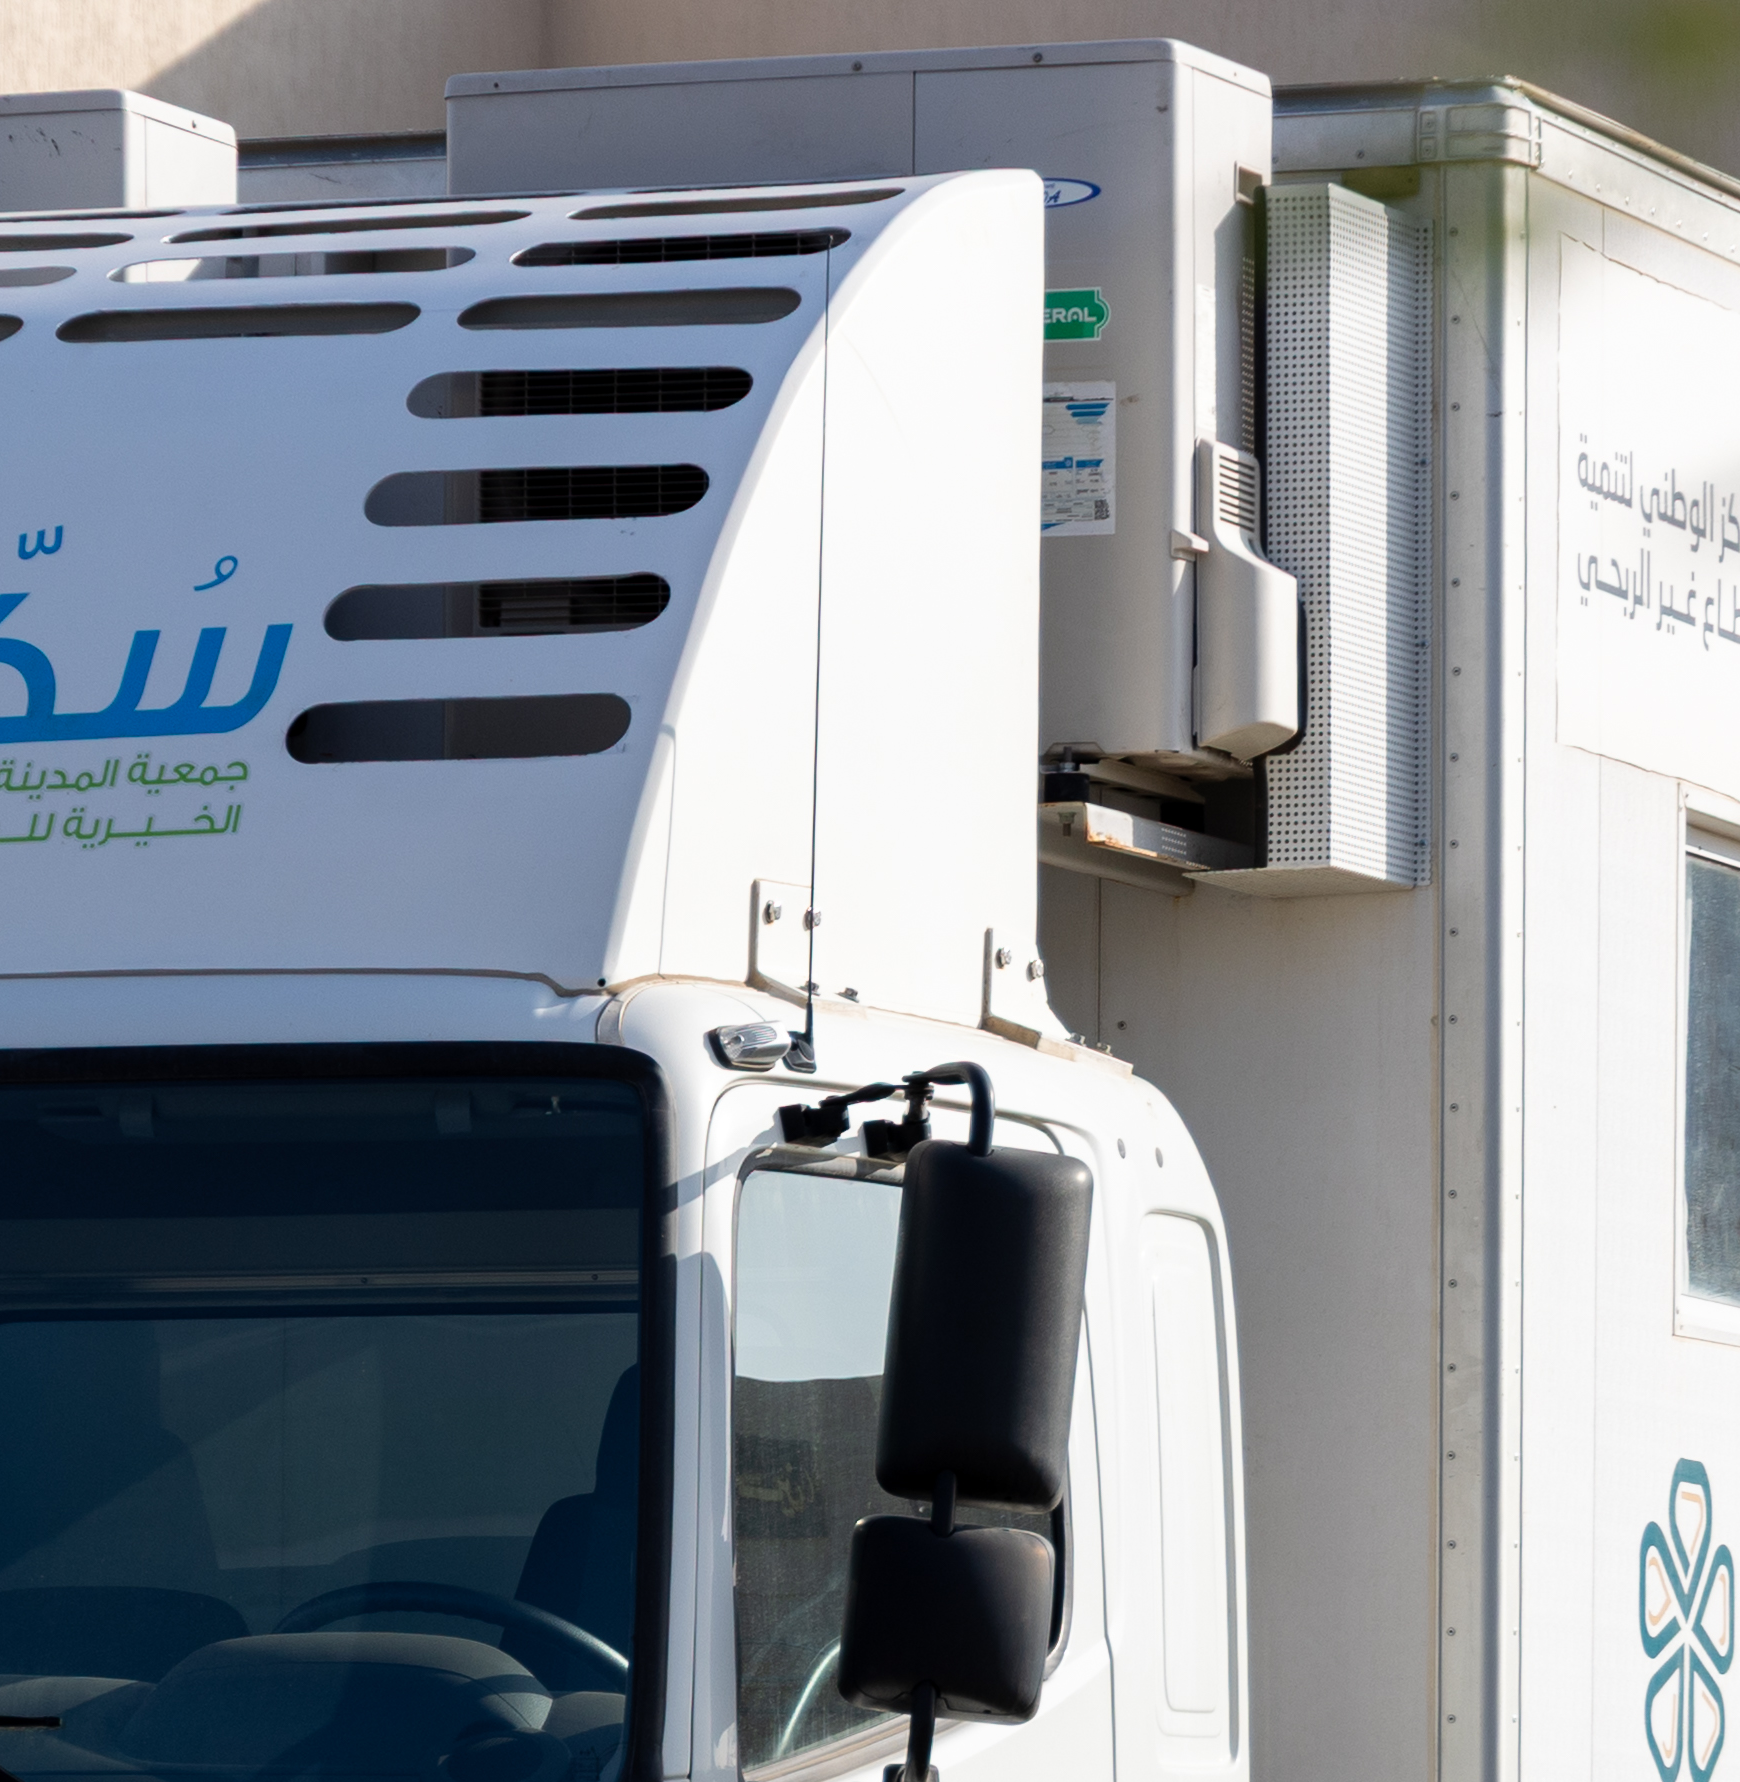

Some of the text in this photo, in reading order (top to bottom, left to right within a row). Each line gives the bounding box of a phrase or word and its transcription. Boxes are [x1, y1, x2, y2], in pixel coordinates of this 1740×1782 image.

[1578, 433, 1633, 511] لتنمية
[1640, 468, 1714, 553] الوطني
[1577, 548, 1650, 621] الربحي
[1656, 571, 1696, 635] غير
[126, 753, 249, 795] جمعية
[62, 804, 241, 850] الخيرية
